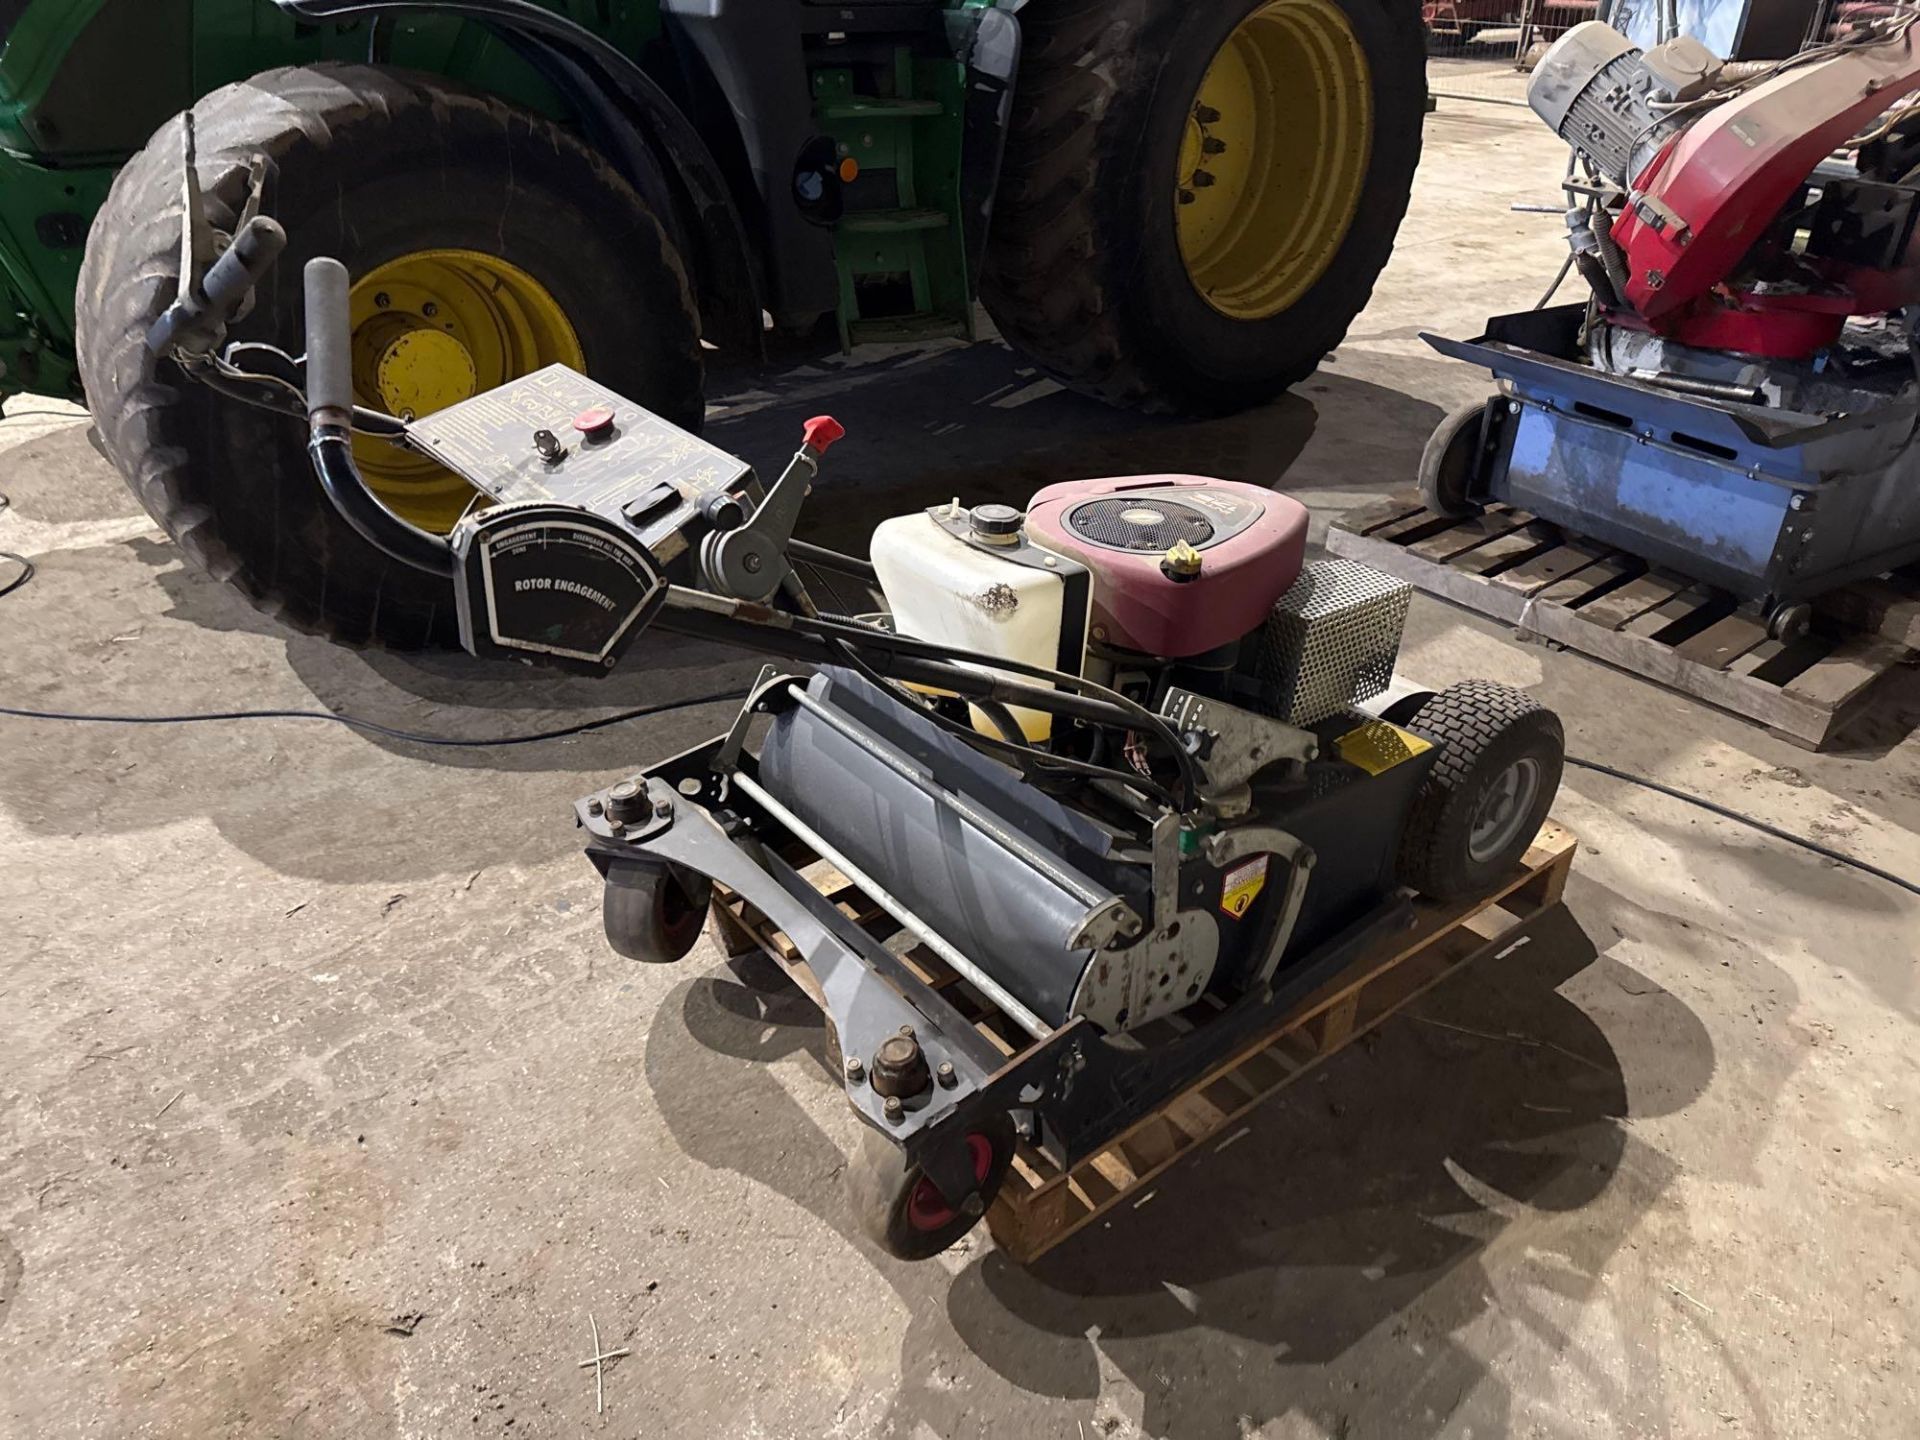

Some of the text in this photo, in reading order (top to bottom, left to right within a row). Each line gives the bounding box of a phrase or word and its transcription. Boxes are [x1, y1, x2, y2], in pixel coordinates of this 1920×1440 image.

[496, 532, 537, 549] ENGAGEMENT
[515, 578, 617, 611] ROTOR ENGAGEMENT
